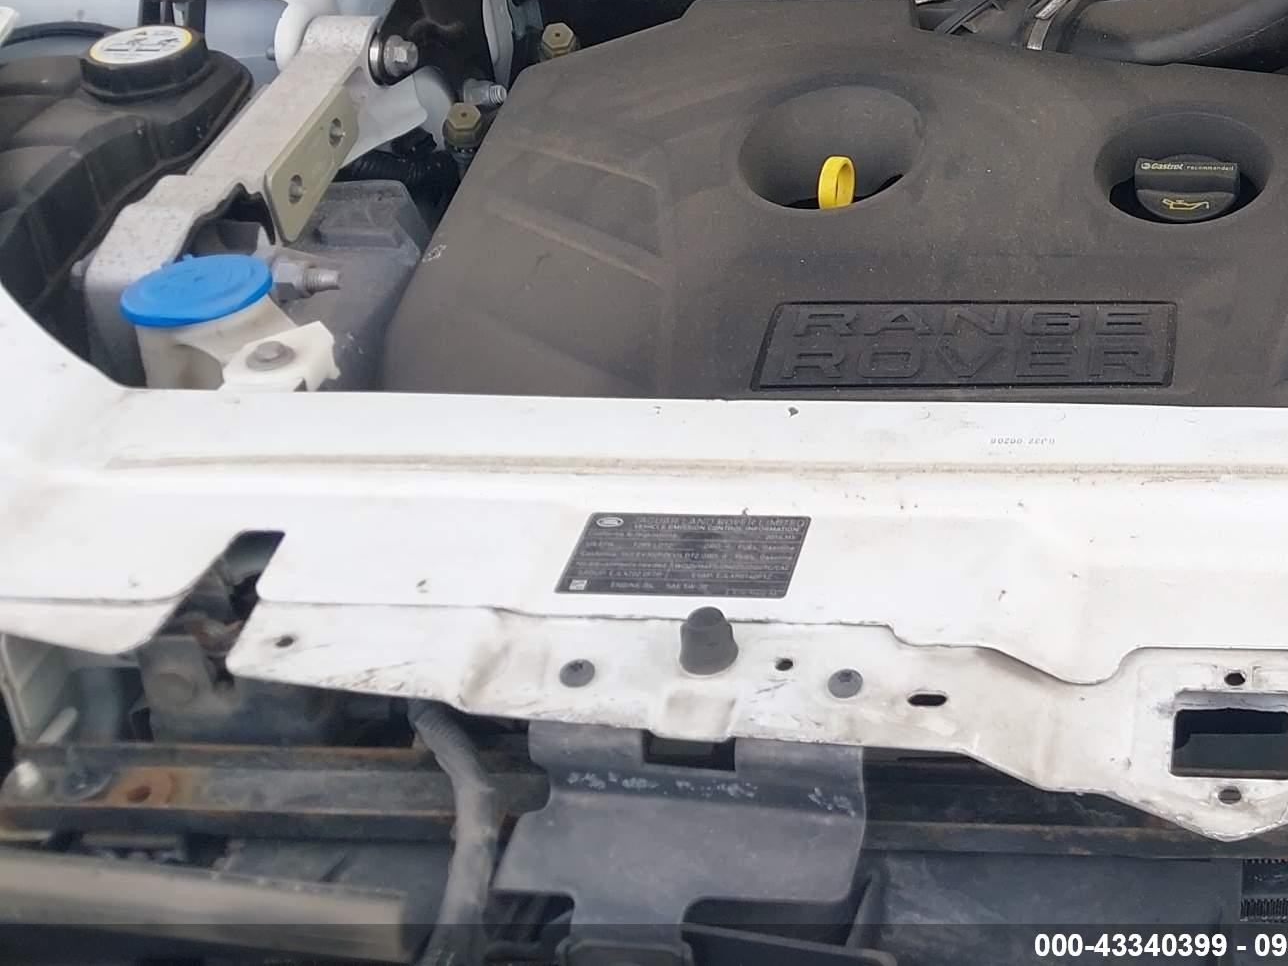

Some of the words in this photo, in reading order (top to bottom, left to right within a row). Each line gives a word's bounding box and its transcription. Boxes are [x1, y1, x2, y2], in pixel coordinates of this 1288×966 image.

[1150, 162, 1184, 171] Castrol
[795, 306, 1153, 336] RANGE
[780, 344, 1154, 379] ROVER
